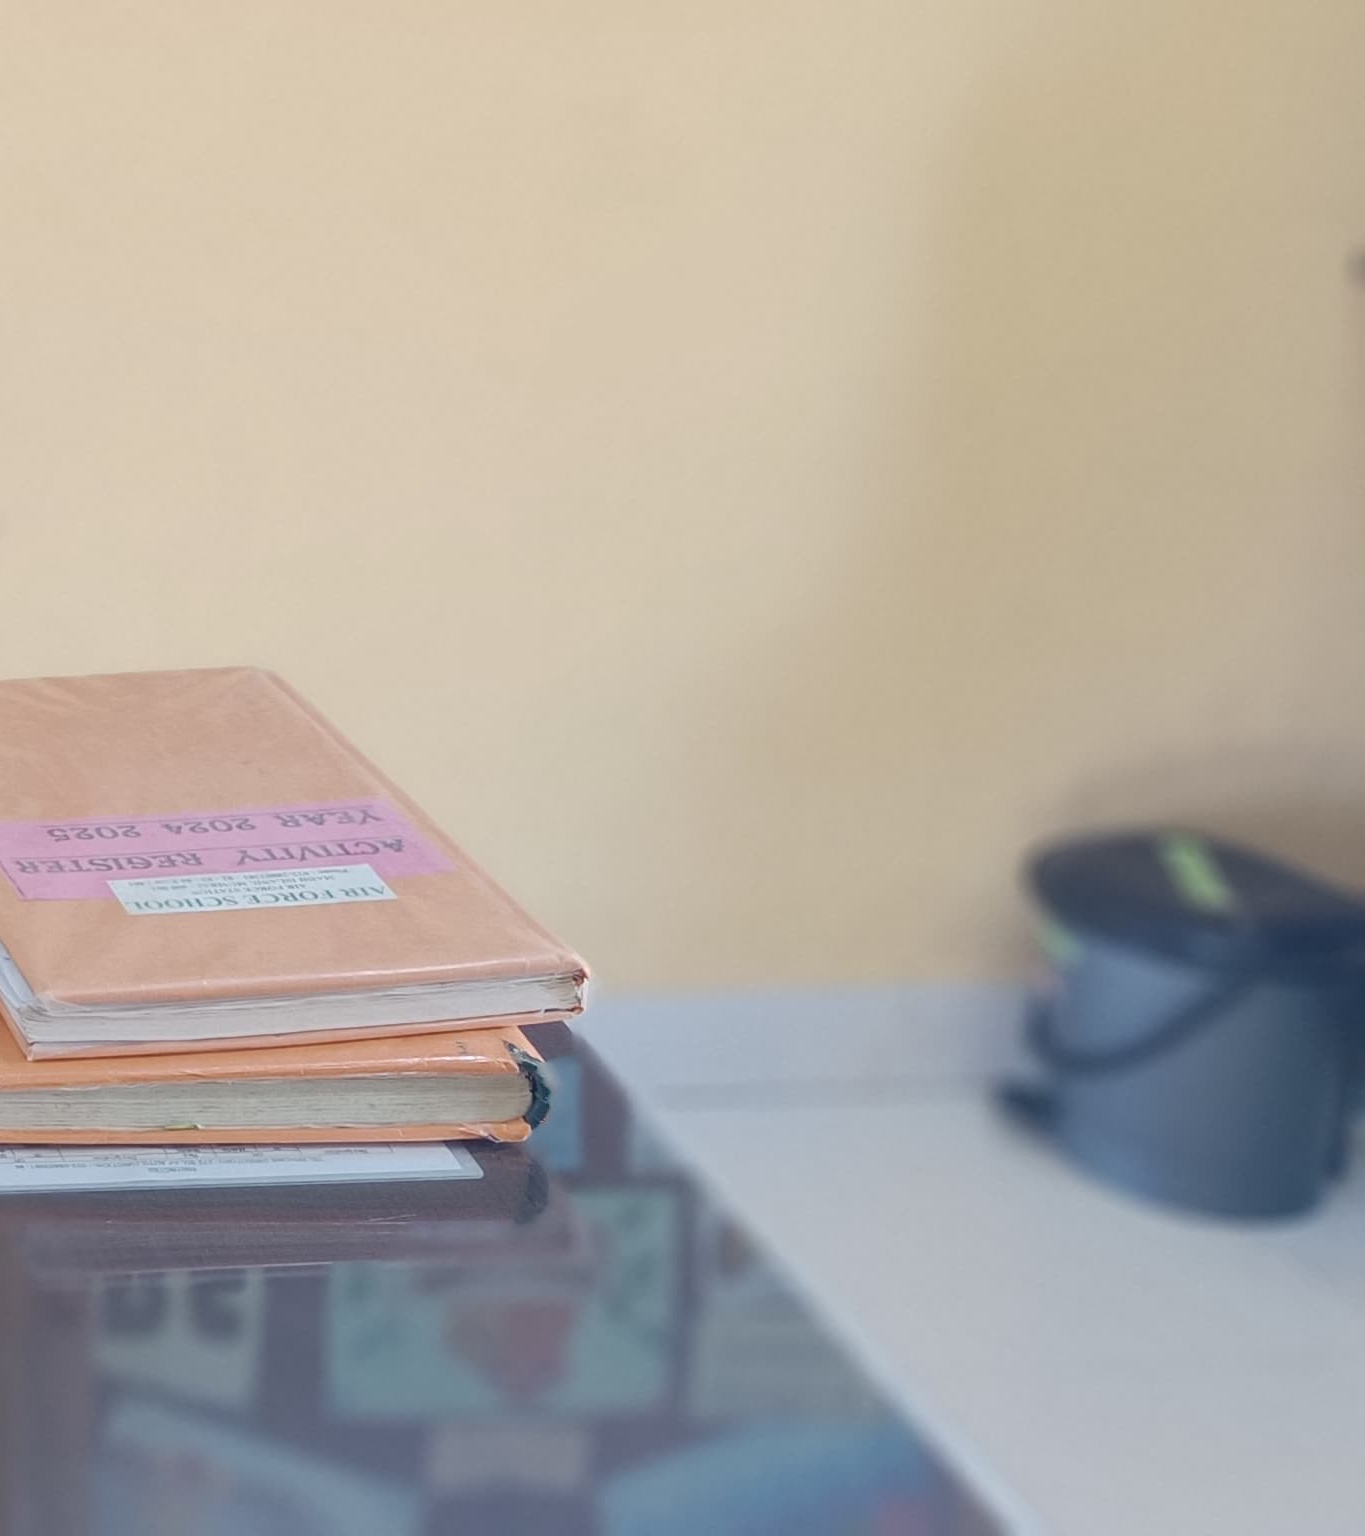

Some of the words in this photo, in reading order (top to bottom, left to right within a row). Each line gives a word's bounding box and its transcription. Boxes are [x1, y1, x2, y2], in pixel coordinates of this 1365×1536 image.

[160, 818, 257, 835] 2024
[273, 810, 383, 829] YEAR
[44, 824, 142, 842] 2025
[236, 839, 405, 866] ACTIVITY
[14, 853, 205, 874] REGISTER
[243, 890, 333, 905] FORCE
[338, 886, 386, 897] AIR
[126, 896, 238, 910] SCHOOL
